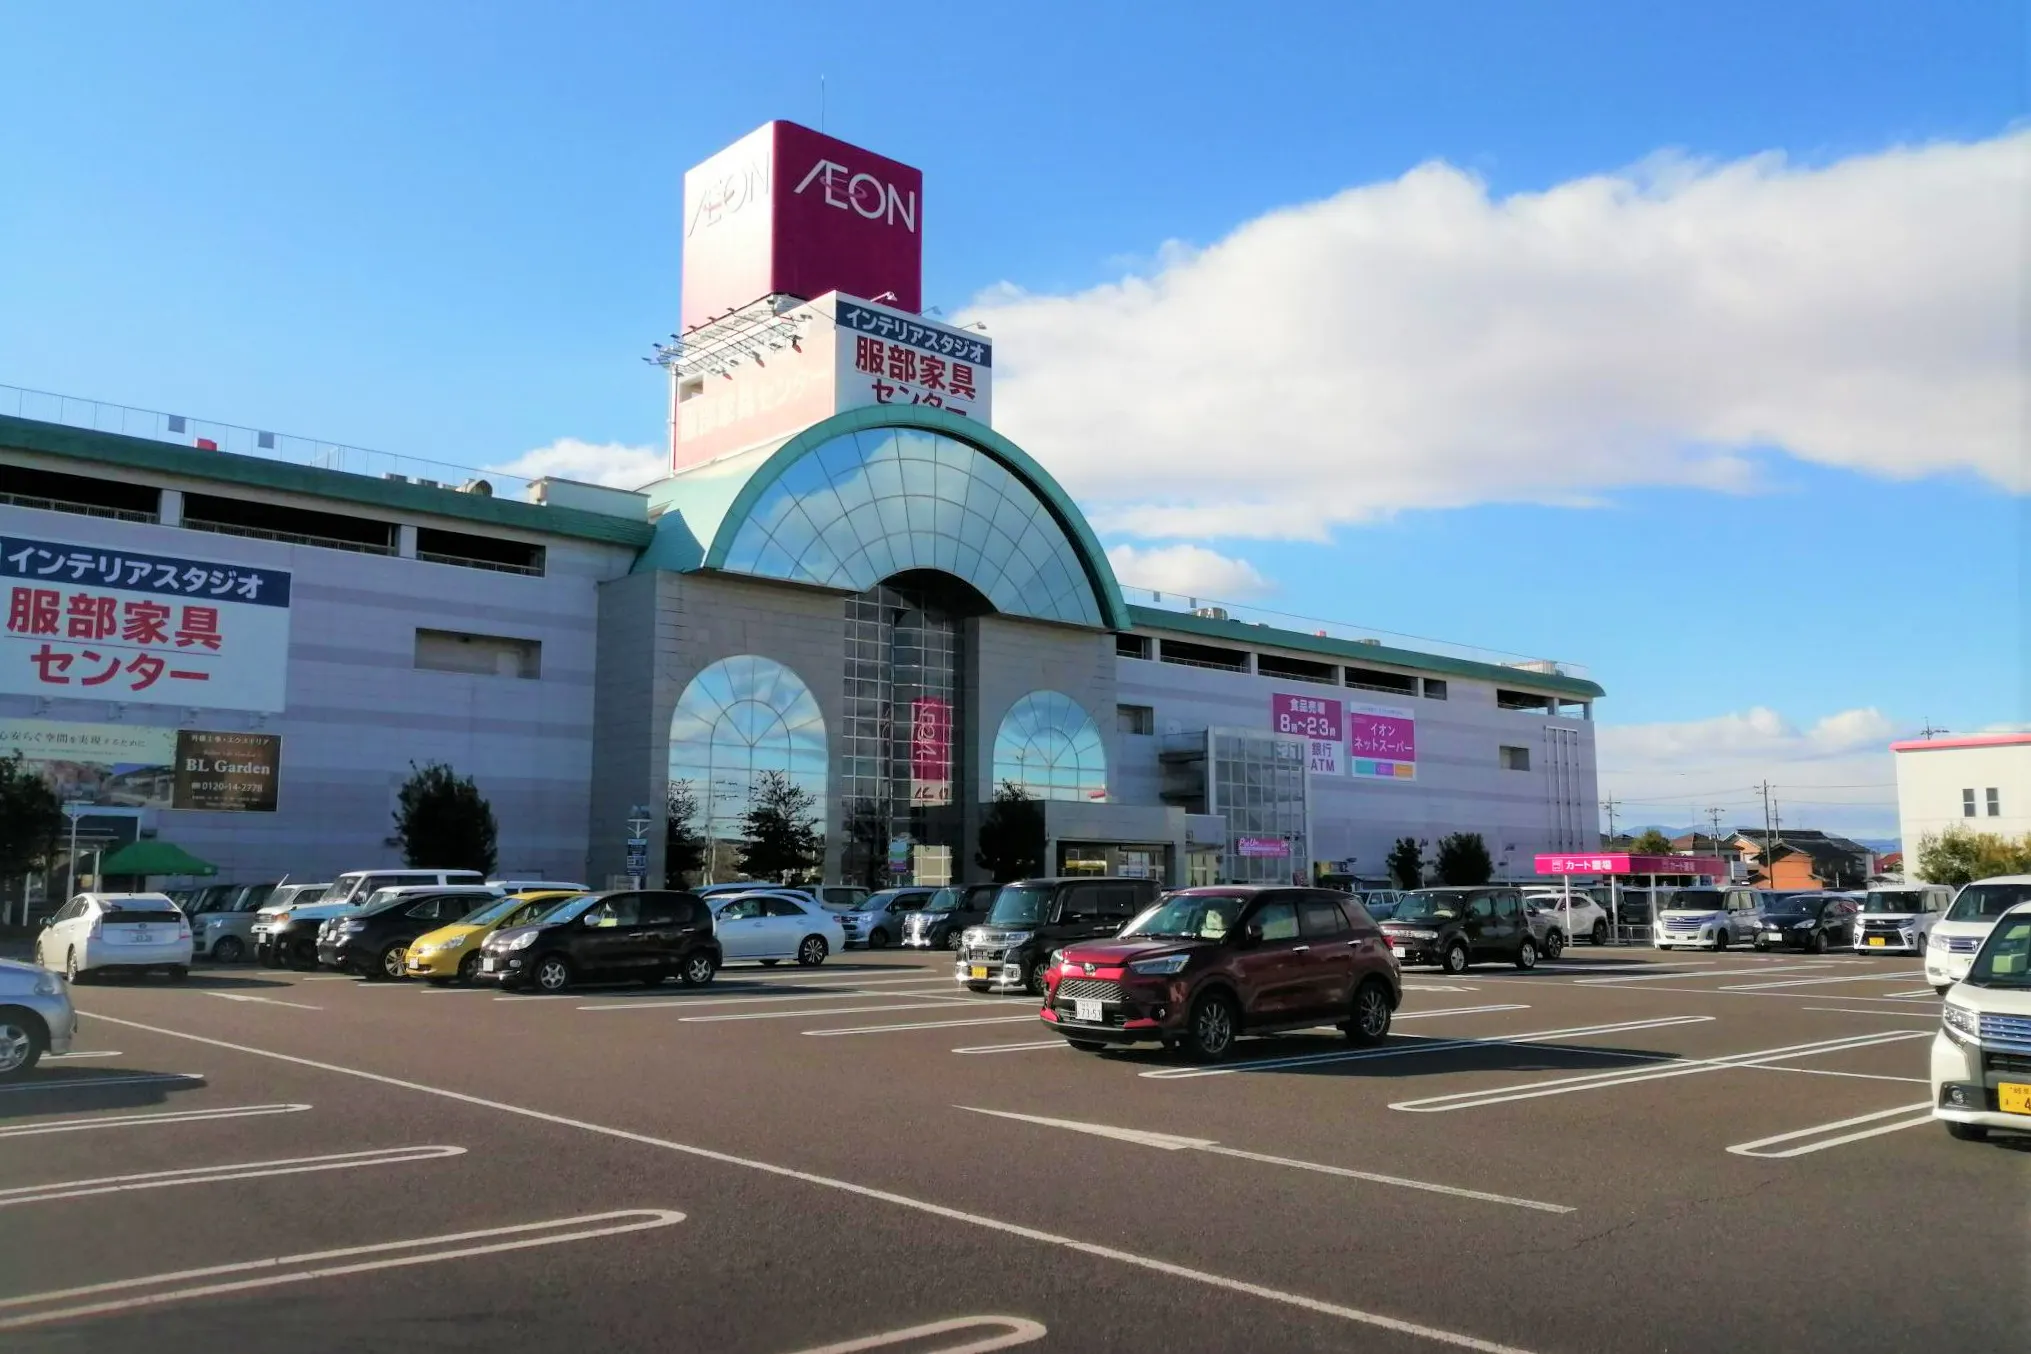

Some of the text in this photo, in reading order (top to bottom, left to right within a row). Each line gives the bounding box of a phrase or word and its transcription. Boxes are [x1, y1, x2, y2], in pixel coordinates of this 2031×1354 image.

[846, 308, 986, 363] インテリアスタジオ
[855, 335, 977, 400] 服部家具
[8, 546, 264, 599] インテリアスタジオ
[6, 586, 223, 650] 服部家具
[30, 644, 210, 691] センター
[1289, 698, 1326, 715] 食品売
[1370, 722, 1396, 737] イオン
[1354, 735, 1413, 752] ネットスーパー
[185, 758, 271, 775] BL Garden
[1310, 758, 1335, 772] ATM
[1670, 861, 1696, 872] カート
